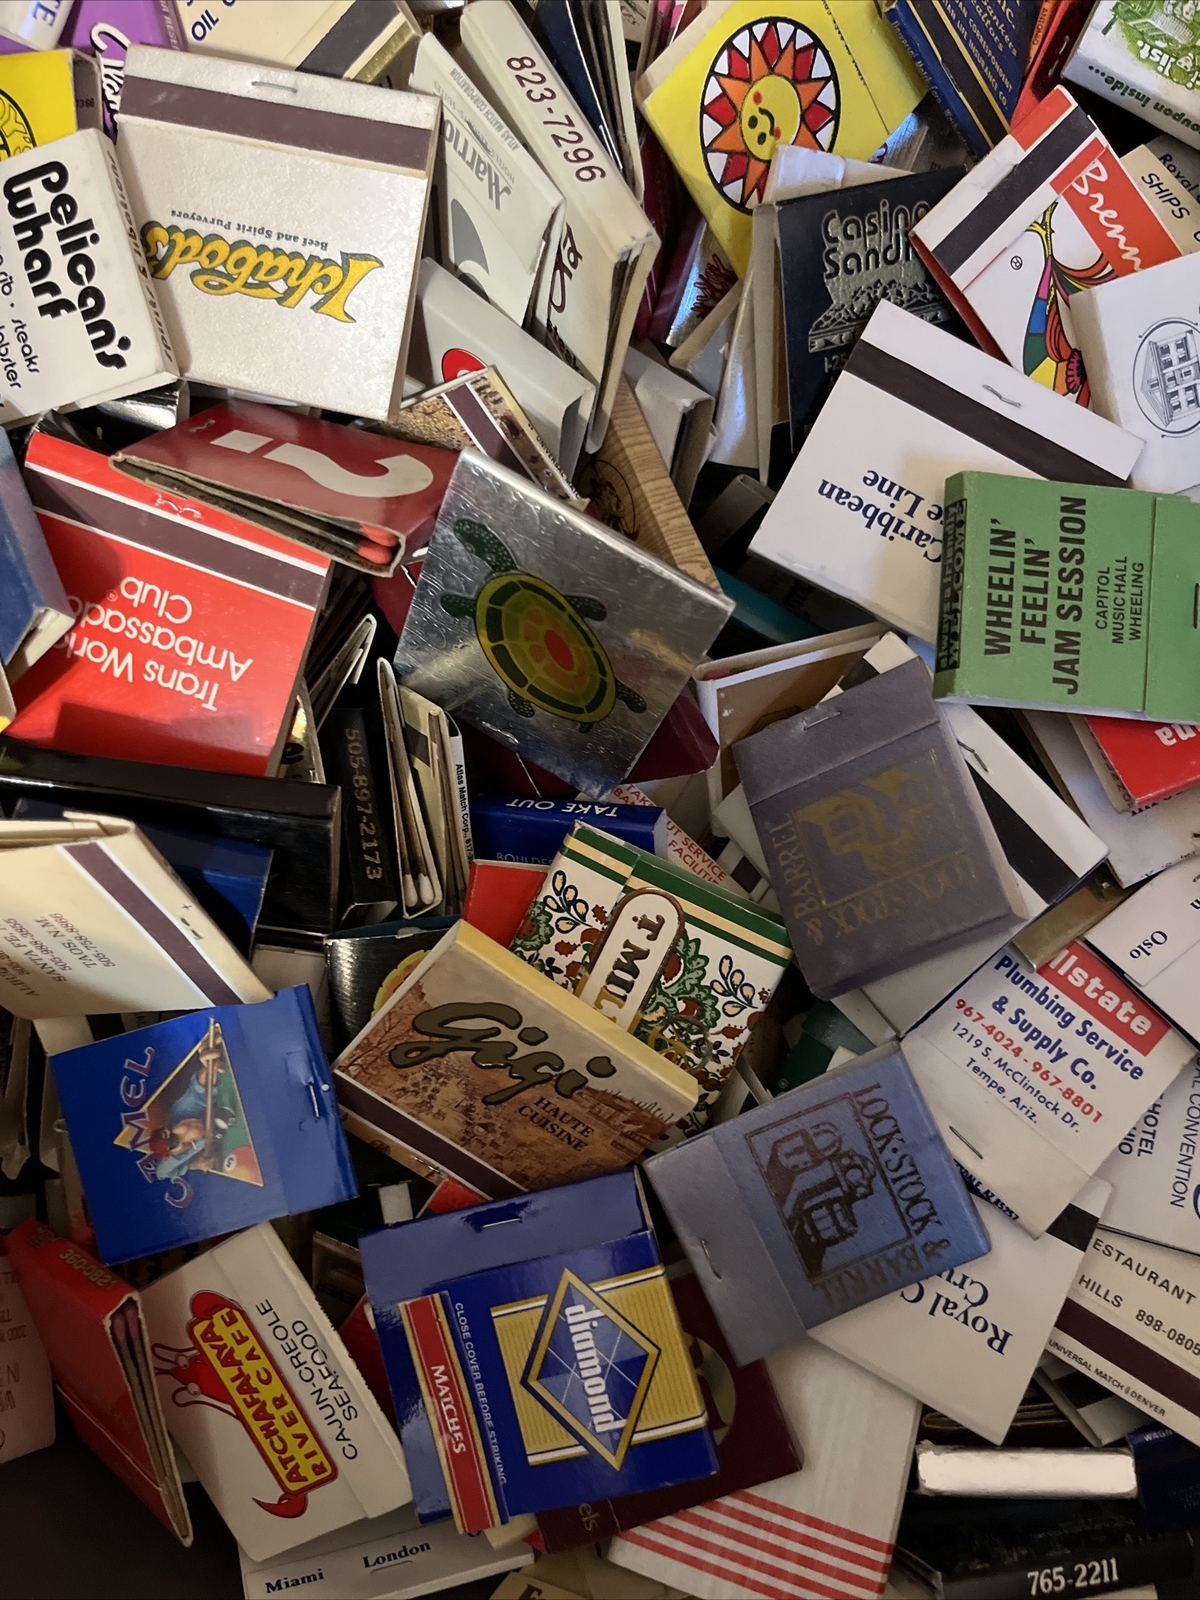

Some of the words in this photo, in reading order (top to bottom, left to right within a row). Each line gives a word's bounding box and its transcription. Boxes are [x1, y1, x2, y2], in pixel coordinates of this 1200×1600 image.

[191, 9, 219, 42] OIL
[1033, 7, 1048, 47] ANTONIO
[955, 20, 970, 40] LIFE
[966, 39, 1000, 91] INSURANCE
[996, 91, 1011, 110] CO.
[967, 18, 1014, 93] CORRESPONDENT
[449, 67, 488, 113] CORPORATION
[483, 108, 505, 133] MATCH
[499, 129, 521, 152] ATLAS
[505, 55, 606, 184] 823-7296
[171, 209, 232, 230] Purveyors
[1140, 169, 1191, 221] SHIPS
[236, 222, 273, 240] Spirit
[276, 231, 300, 245] and
[302, 237, 328, 251] Beef
[139, 220, 384, 324] Ichabod's
[11, 318, 40, 374] steaks
[861, 469, 926, 510] Line
[816, 478, 944, 565] Caribbean
[951, 500, 966, 666] WELCOME
[983, 517, 1018, 657] WHEELIN'
[1058, 496, 1087, 622] SESSION
[1115, 556, 1128, 599] HALL
[120, 576, 192, 624] Club
[1020, 537, 1050, 646] FEELIN'
[1095, 566, 1110, 631] CAPITOL
[1129, 561, 1145, 642] WHEELING
[1111, 602, 1127, 645] MUSIC
[143, 660, 219, 711] Trans
[1052, 628, 1081, 696] JAM
[454, 763, 466, 785] Atlas
[457, 786, 470, 812] Match
[345, 728, 384, 881] 505-897-2173
[459, 813, 473, 838] Corp.,
[505, 798, 553, 812] OUT
[560, 801, 619, 818] TAKE
[681, 836, 728, 882] SERVICE
[3, 931, 27, 949] FE,
[4, 916, 73, 972] 505-988-3855
[35, 915, 65, 939] N.M.
[50, 911, 116, 969] 505-758-8866
[61, 938, 98, 968] TAOS,
[1129, 930, 1168, 960] Oslo
[24, 950, 67, 982] SANTA
[991, 995, 1009, 1015] &
[1008, 1007, 1068, 1064] Supply
[1070, 1057, 1098, 1090] Co.
[994, 955, 1075, 1029] Plumbing
[1075, 1019, 1144, 1081] Service
[388, 1001, 618, 1105] Gigi
[952, 1021, 981, 1049] 1219
[982, 1046, 993, 1060] S.
[993, 1057, 1060, 1116] McClintock
[1060, 1111, 1080, 1134] Dr.
[955, 999, 1023, 1058] 967-4024
[1031, 1060, 1104, 1123] 967-8801
[534, 1095, 595, 1138] HAUTE
[966, 1056, 1007, 1100] Tempe,
[1009, 1096, 1038, 1124] Ariz.
[119, 1045, 195, 1208] CAMEL
[517, 1105, 588, 1154] CUISINE
[1137, 1104, 1162, 1156] HOTEL
[1168, 1083, 1200, 1210] CONVENTION
[852, 1082, 904, 1155] LOCK
[884, 1156, 942, 1235] STOCK
[921, 1238, 951, 1260] &
[983, 1188, 995, 1200] AZ
[1078, 1274, 1123, 1308] HILLS
[1092, 1238, 1197, 1305] ESTAURANT
[218, 1307, 273, 1387] CAFE
[927, 1289, 1013, 1355] Royal
[255, 1298, 359, 1462] CAJUN-CREOLE
[290, 1319, 359, 1421] SEAFOOD
[454, 1302, 471, 1339] CLOSE
[464, 1341, 483, 1380] COVER
[475, 1382, 494, 1428] BEFORE
[564, 1303, 628, 1434] diamond
[1048, 1338, 1093, 1373] UNIVERSAL
[1093, 1365, 1124, 1394] MATCH
[1130, 1391, 1167, 1418] DENVER
[199, 1318, 309, 1485] ATCHAFALAYA
[430, 1364, 467, 1454] MATCHES
[277, 1399, 333, 1478] RIVER
[264, 1567, 326, 1594] Miami
[361, 1543, 433, 1570] London
[1026, 1557, 1120, 1596] 765-2211
